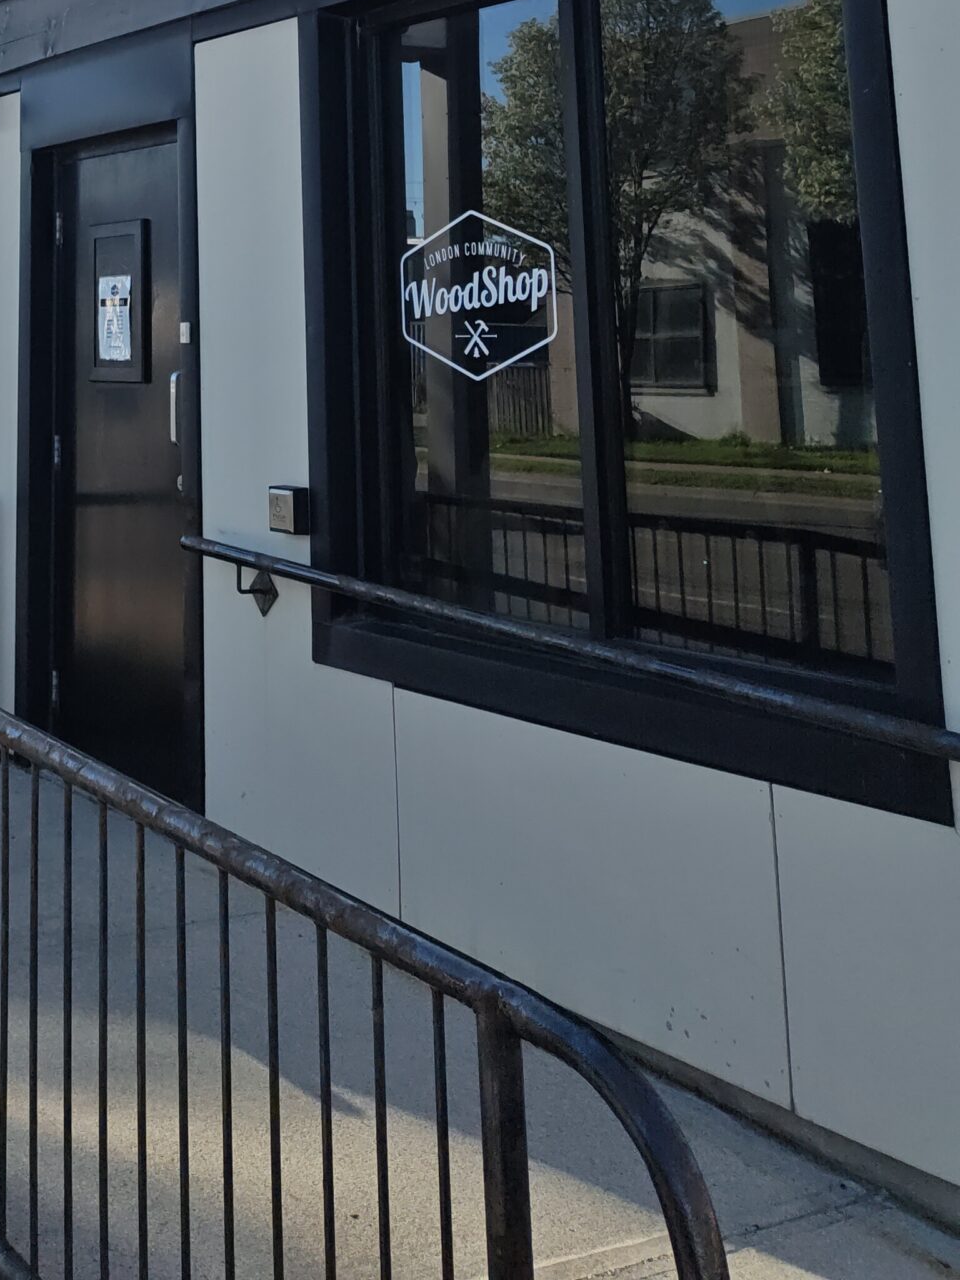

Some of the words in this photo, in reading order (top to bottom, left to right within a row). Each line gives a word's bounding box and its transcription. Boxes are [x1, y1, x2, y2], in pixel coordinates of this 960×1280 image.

[423, 244, 460, 270] LONDON
[464, 241, 527, 267] COMMUNITY
[405, 265, 548, 319] WoodShop
